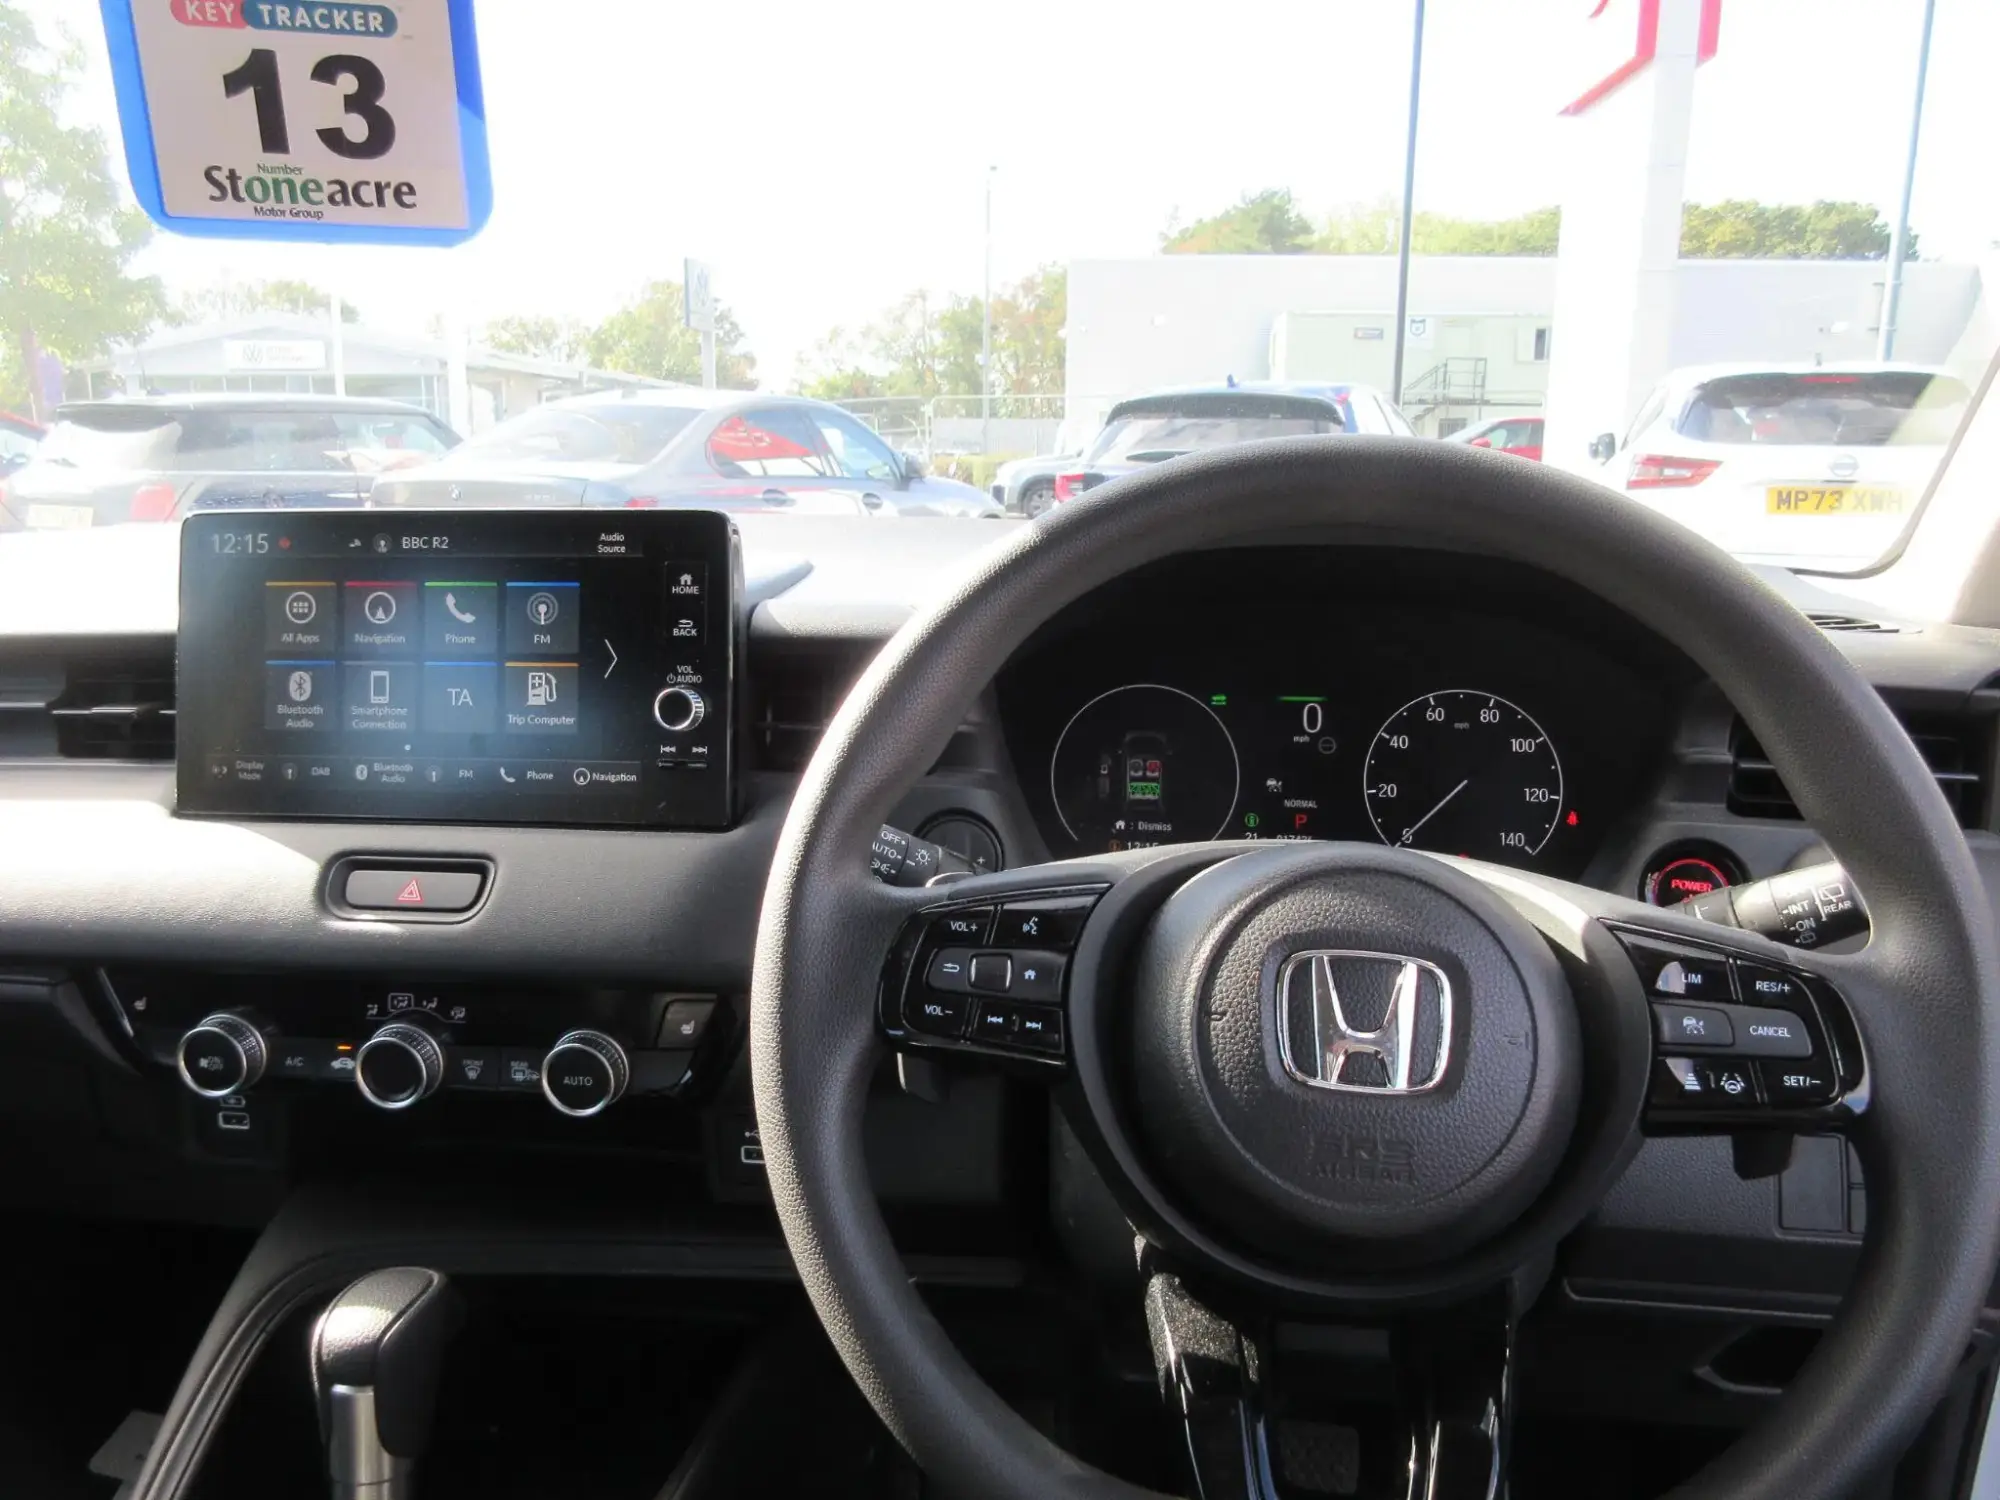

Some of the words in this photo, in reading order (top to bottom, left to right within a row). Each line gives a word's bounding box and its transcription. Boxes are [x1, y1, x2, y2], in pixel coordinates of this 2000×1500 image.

[184, 0, 237, 24] KEY
[256, 5, 385, 33] TRACKER
[222, 48, 397, 160] 13
[257, 163, 304, 176] Number
[203, 166, 417, 210] Stoneacre
[254, 206, 286, 219] Motor
[289, 207, 324, 221] Group
[1776, 490, 1844, 511] MP73
[211, 533, 269, 555] 12:15
[402, 536, 429, 549] BBC
[433, 536, 449, 549] R2
[600, 532, 625, 543] Audio
[597, 544, 626, 554] Source
[672, 585, 699, 595] HOME
[445, 633, 476, 644] Phone
[673, 627, 697, 637] BACK
[281, 633, 294, 643] All
[296, 633, 320, 646] Apps
[354, 633, 406, 646] Navigation
[534, 634, 551, 645] FM
[677, 665, 693, 674] VOL
[677, 674, 702, 684] AUDIO
[447, 688, 473, 706] TA
[277, 704, 324, 716] Bluetooth
[351, 705, 408, 718] Smartphone
[1426, 707, 1445, 721] 60
[1480, 709, 1499, 723] 80
[286, 718, 314, 729] Audio
[352, 720, 407, 731] Connection
[508, 714, 526, 727] Trip
[527, 714, 576, 727] Computer
[1293, 734, 1310, 743] mph
[1390, 735, 1409, 749] 40
[1511, 738, 1535, 753] 100
[373, 762, 414, 773] Bluetooth
[459, 769, 474, 779] FM
[381, 773, 406, 783] Audio
[527, 769, 554, 781] Phone
[592, 772, 637, 784] Navigation
[1378, 784, 1398, 798] 20
[1524, 788, 1549, 803] 120
[1284, 799, 1318, 809] NORMAL
[1138, 821, 1172, 832] Dismiss
[1295, 814, 1307, 829] P
[881, 830, 901, 845] OFF
[1500, 832, 1525, 847] 140
[1671, 878, 1713, 893] POWER
[1823, 899, 1853, 914] REAR
[1795, 917, 1816, 932] ON
[1682, 972, 1702, 985] LIM
[1750, 1025, 1791, 1038] CANCEL
[285, 1056, 304, 1067] A/C
[563, 1074, 593, 1086] AUTO
